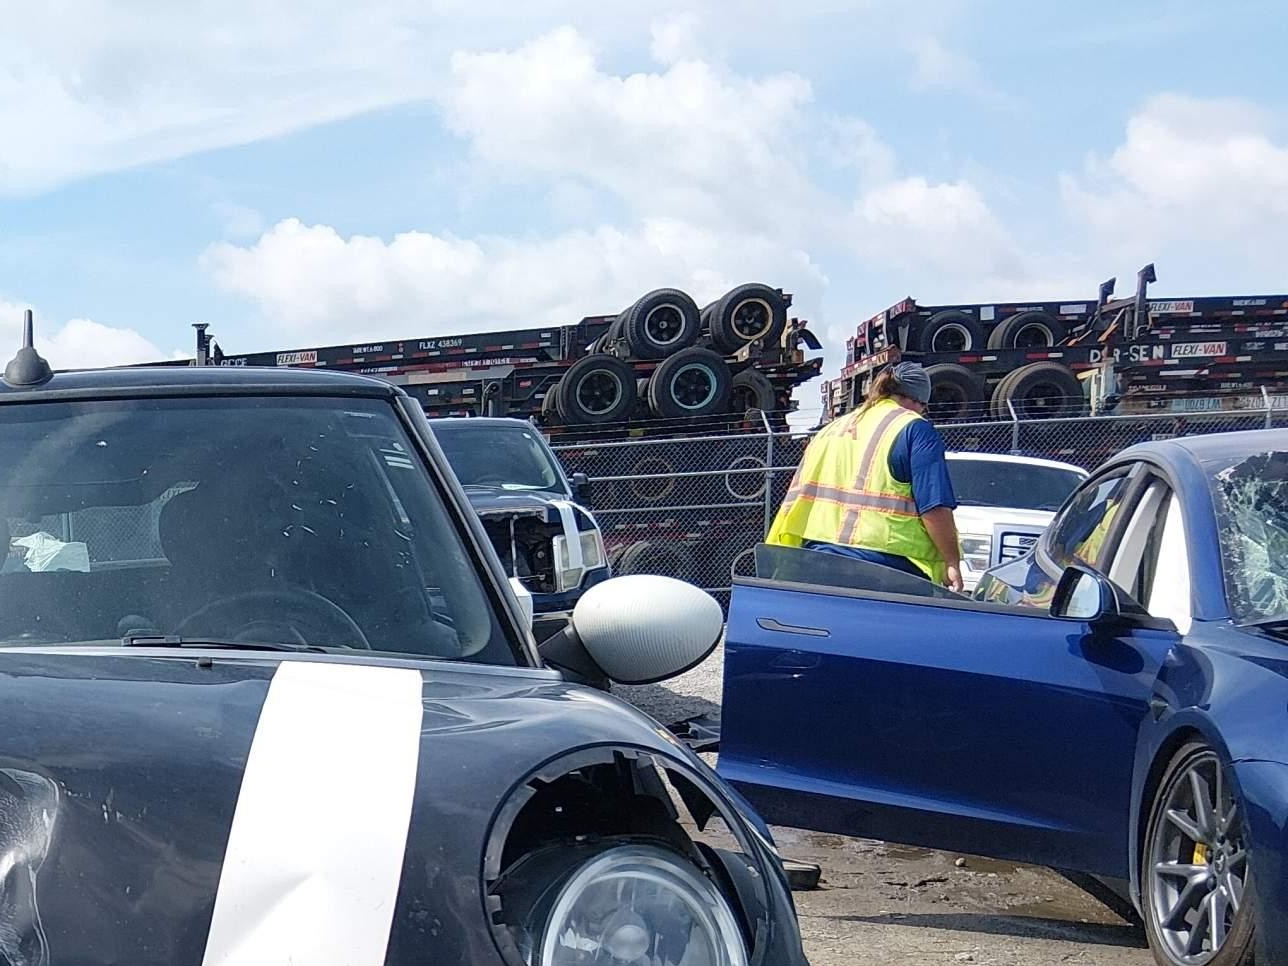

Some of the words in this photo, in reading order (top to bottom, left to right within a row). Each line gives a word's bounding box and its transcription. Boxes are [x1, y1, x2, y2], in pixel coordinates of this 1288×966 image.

[1148, 302, 1193, 312] FLEXI-VAN
[1172, 343, 1225, 356] FLEXI-VAN
[277, 353, 317, 365] FLEXI-VAN
